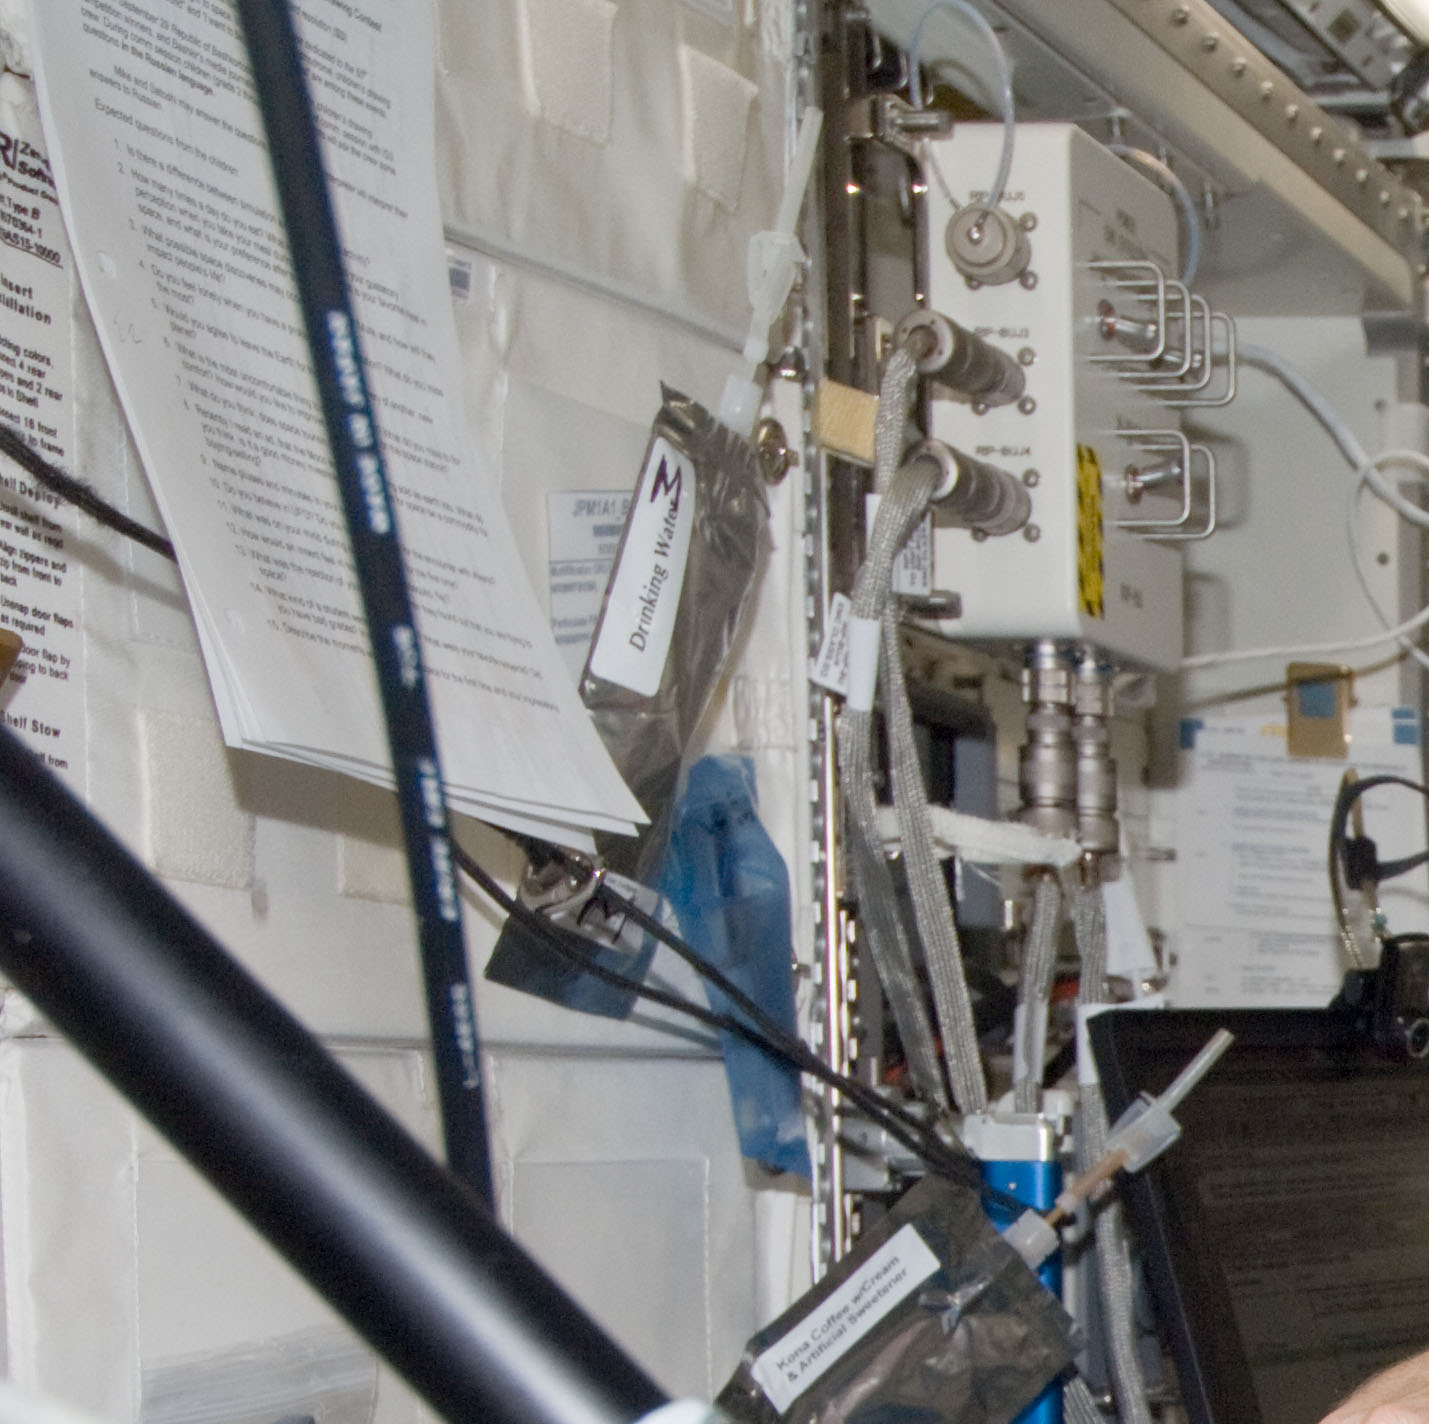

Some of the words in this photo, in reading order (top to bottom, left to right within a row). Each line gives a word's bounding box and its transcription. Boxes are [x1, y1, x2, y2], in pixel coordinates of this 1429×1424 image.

[629, 564, 668, 652] Drinking
[32, 719, 61, 738] Stow
[776, 1342, 810, 1371] Kona
[811, 1304, 850, 1341] Coffee
